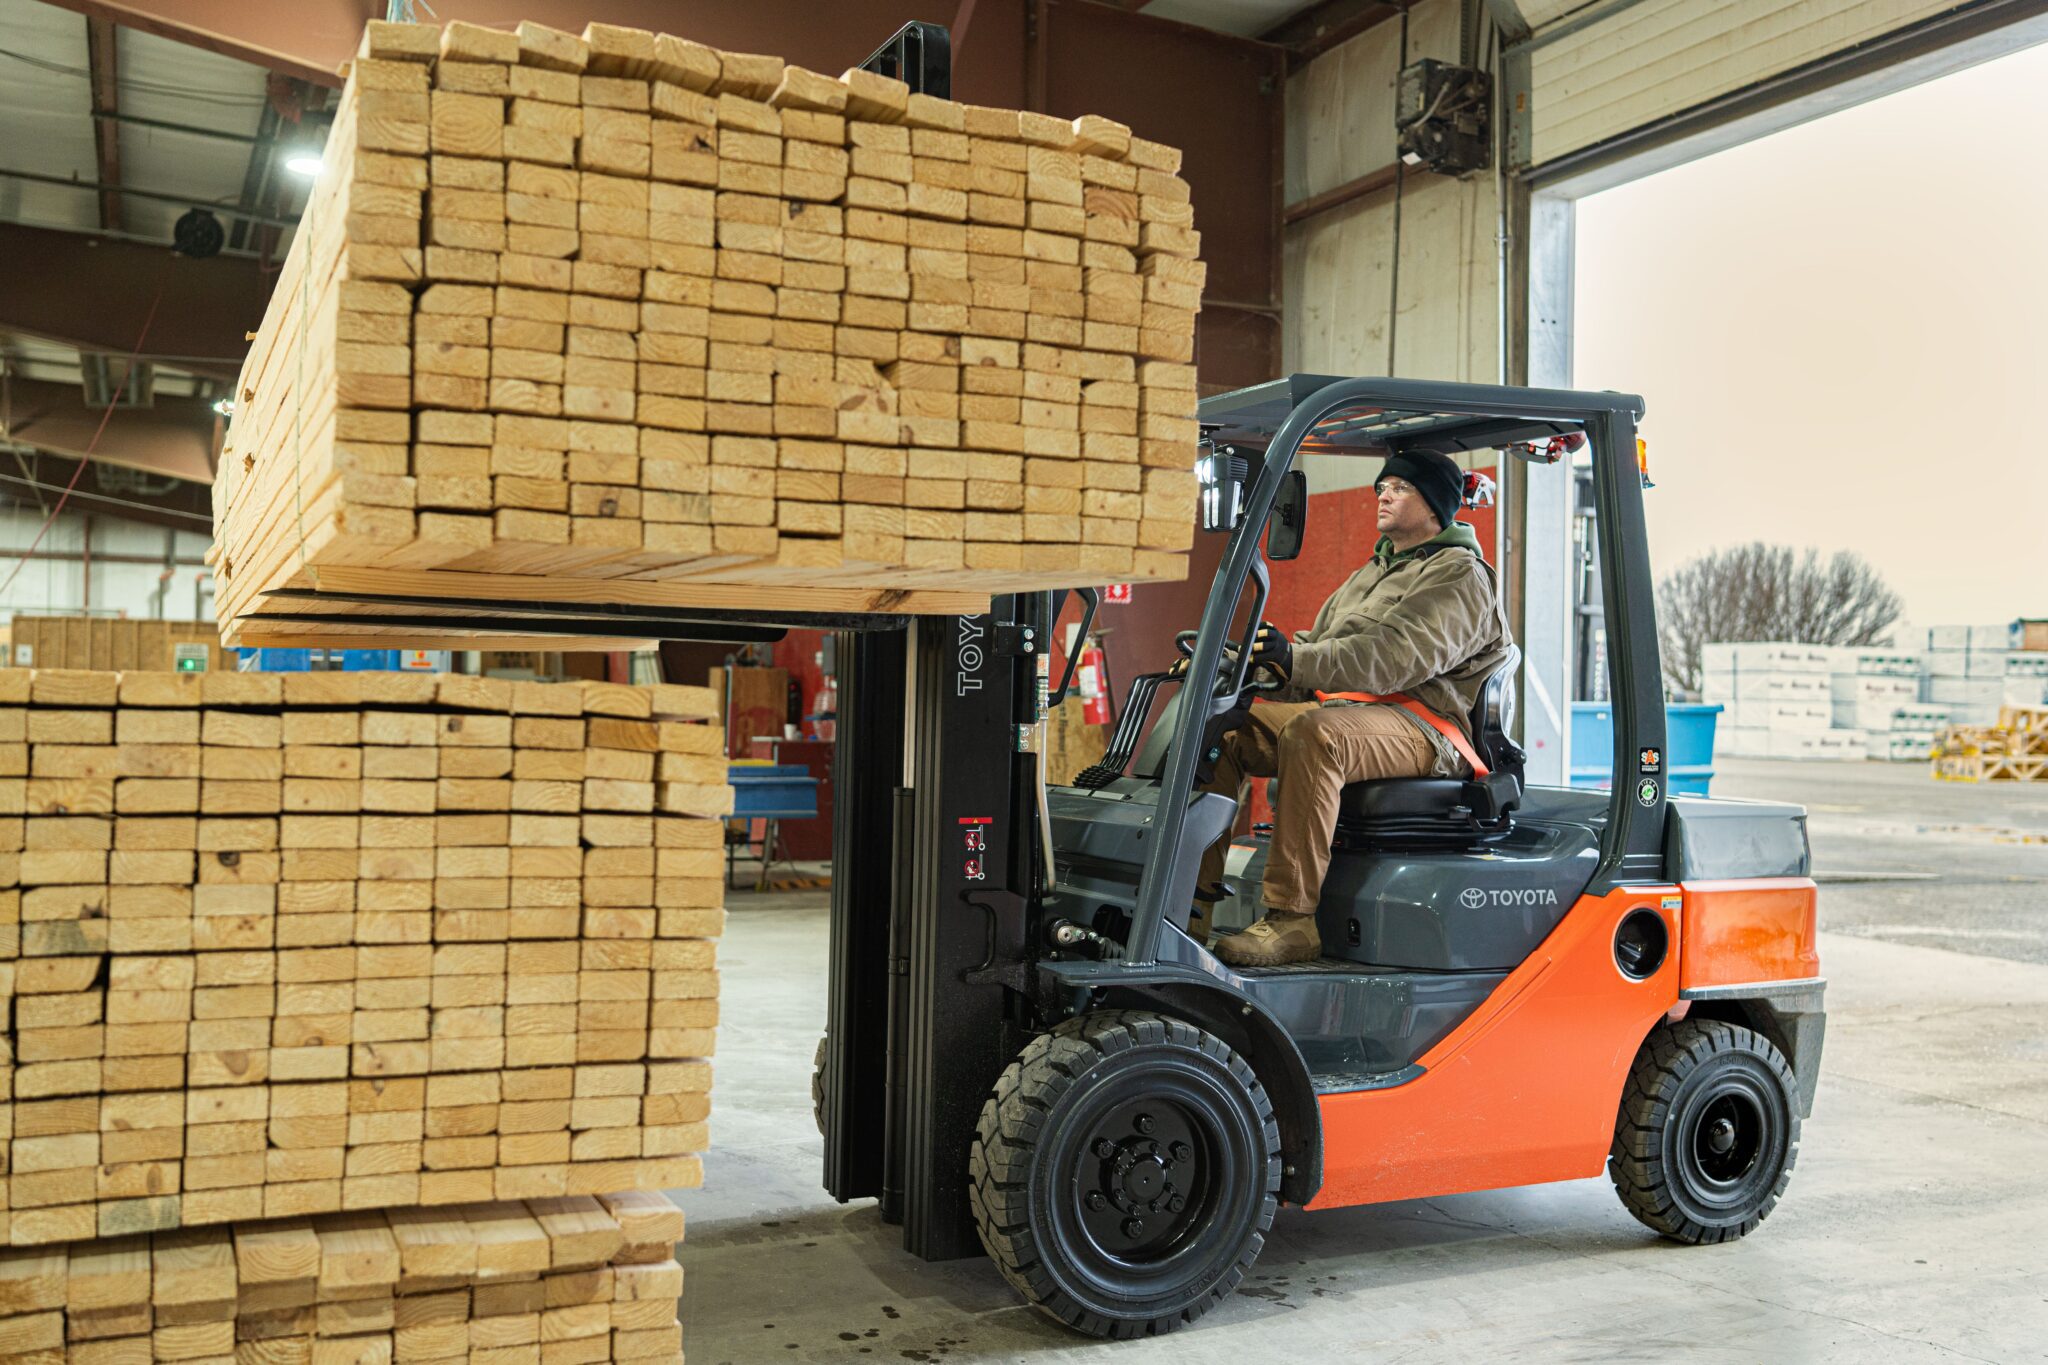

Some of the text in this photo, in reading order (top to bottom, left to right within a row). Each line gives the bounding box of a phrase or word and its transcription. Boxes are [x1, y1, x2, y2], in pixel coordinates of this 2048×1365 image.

[957, 613, 984, 697] TOY
[1641, 750, 1659, 765] SAS
[1489, 889, 1558, 906] TOYOTA
